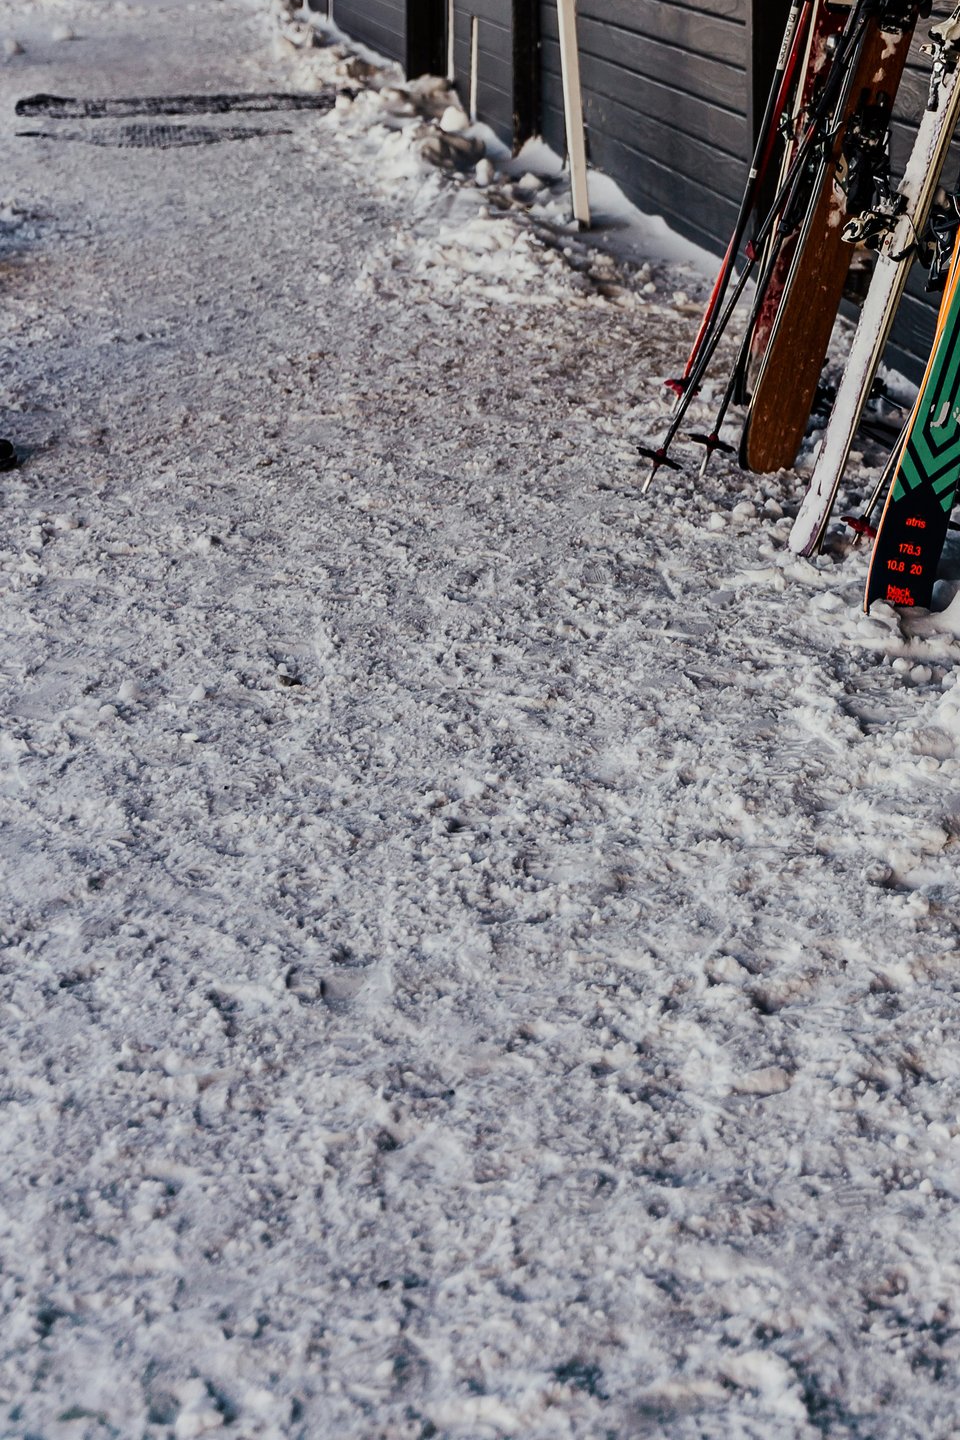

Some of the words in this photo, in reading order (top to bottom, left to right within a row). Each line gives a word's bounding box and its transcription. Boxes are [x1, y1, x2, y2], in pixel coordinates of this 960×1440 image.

[777, 24, 793, 65] salomon
[905, 517, 926, 529] atris
[899, 543, 922, 556] 178.3
[886, 559, 905, 572] 10.8
[910, 562, 923, 575] 20
[887, 583, 911, 598] black
